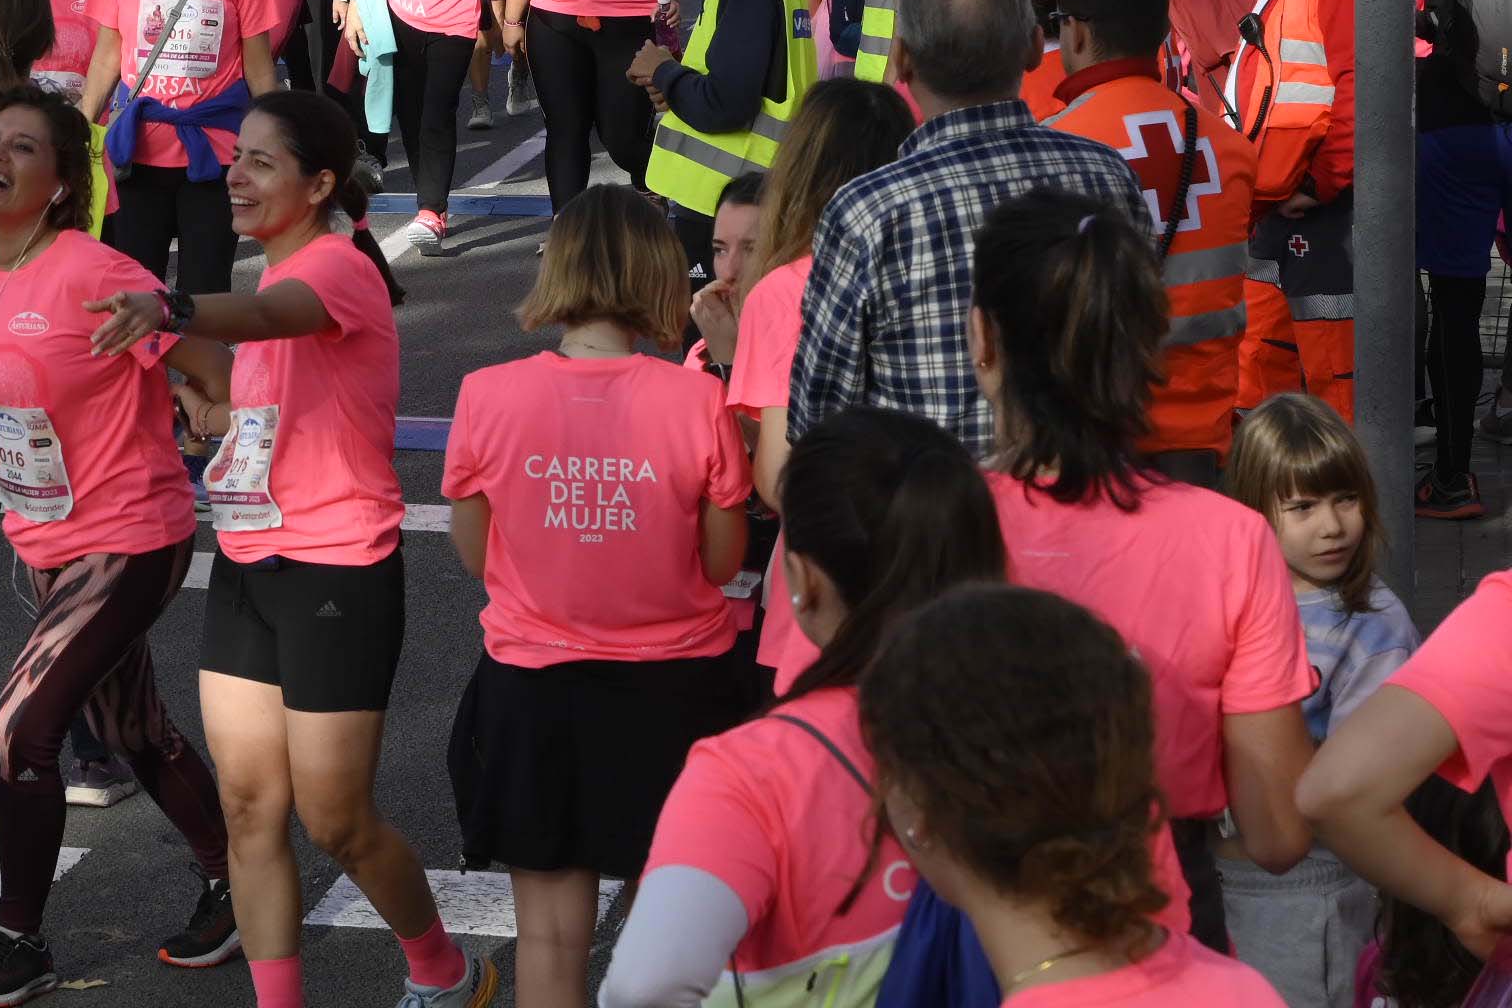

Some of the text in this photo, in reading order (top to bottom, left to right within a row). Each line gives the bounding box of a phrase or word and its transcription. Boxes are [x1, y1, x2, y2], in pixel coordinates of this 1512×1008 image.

[0, 448, 25, 468] 016
[524, 454, 657, 483] CARRERA
[550, 480, 631, 506] DE LA
[544, 504, 637, 531] MUJER
[579, 533, 603, 543] 2023
